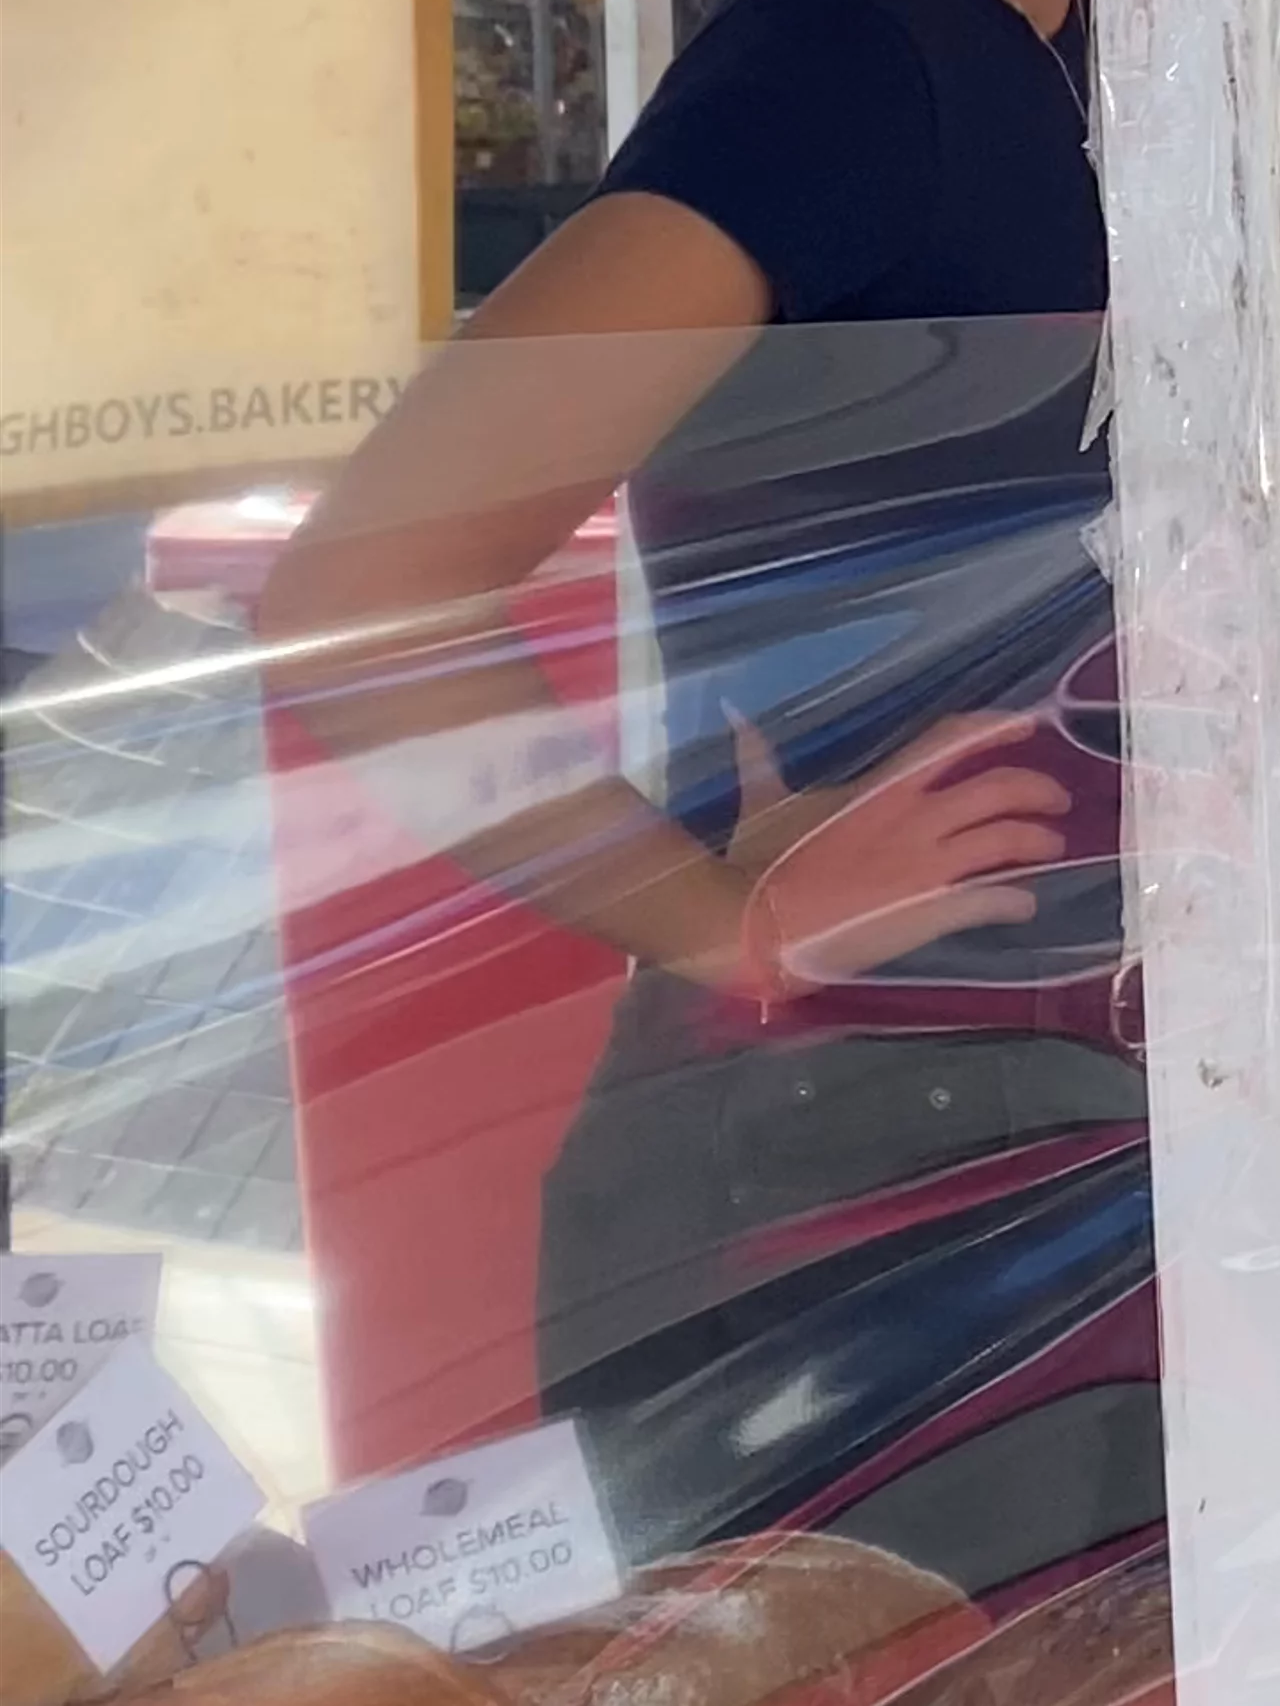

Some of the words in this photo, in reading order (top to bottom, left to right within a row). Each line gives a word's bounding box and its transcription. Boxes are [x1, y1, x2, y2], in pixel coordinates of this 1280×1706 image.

[35, 1408, 184, 1567] SOURDOUGH
[71, 1522, 132, 1596] LOAF
[131, 1454, 204, 1535] $10.00
[351, 1501, 570, 1588] WHOLEMEAL
[469, 1541, 572, 1595] $10.00
